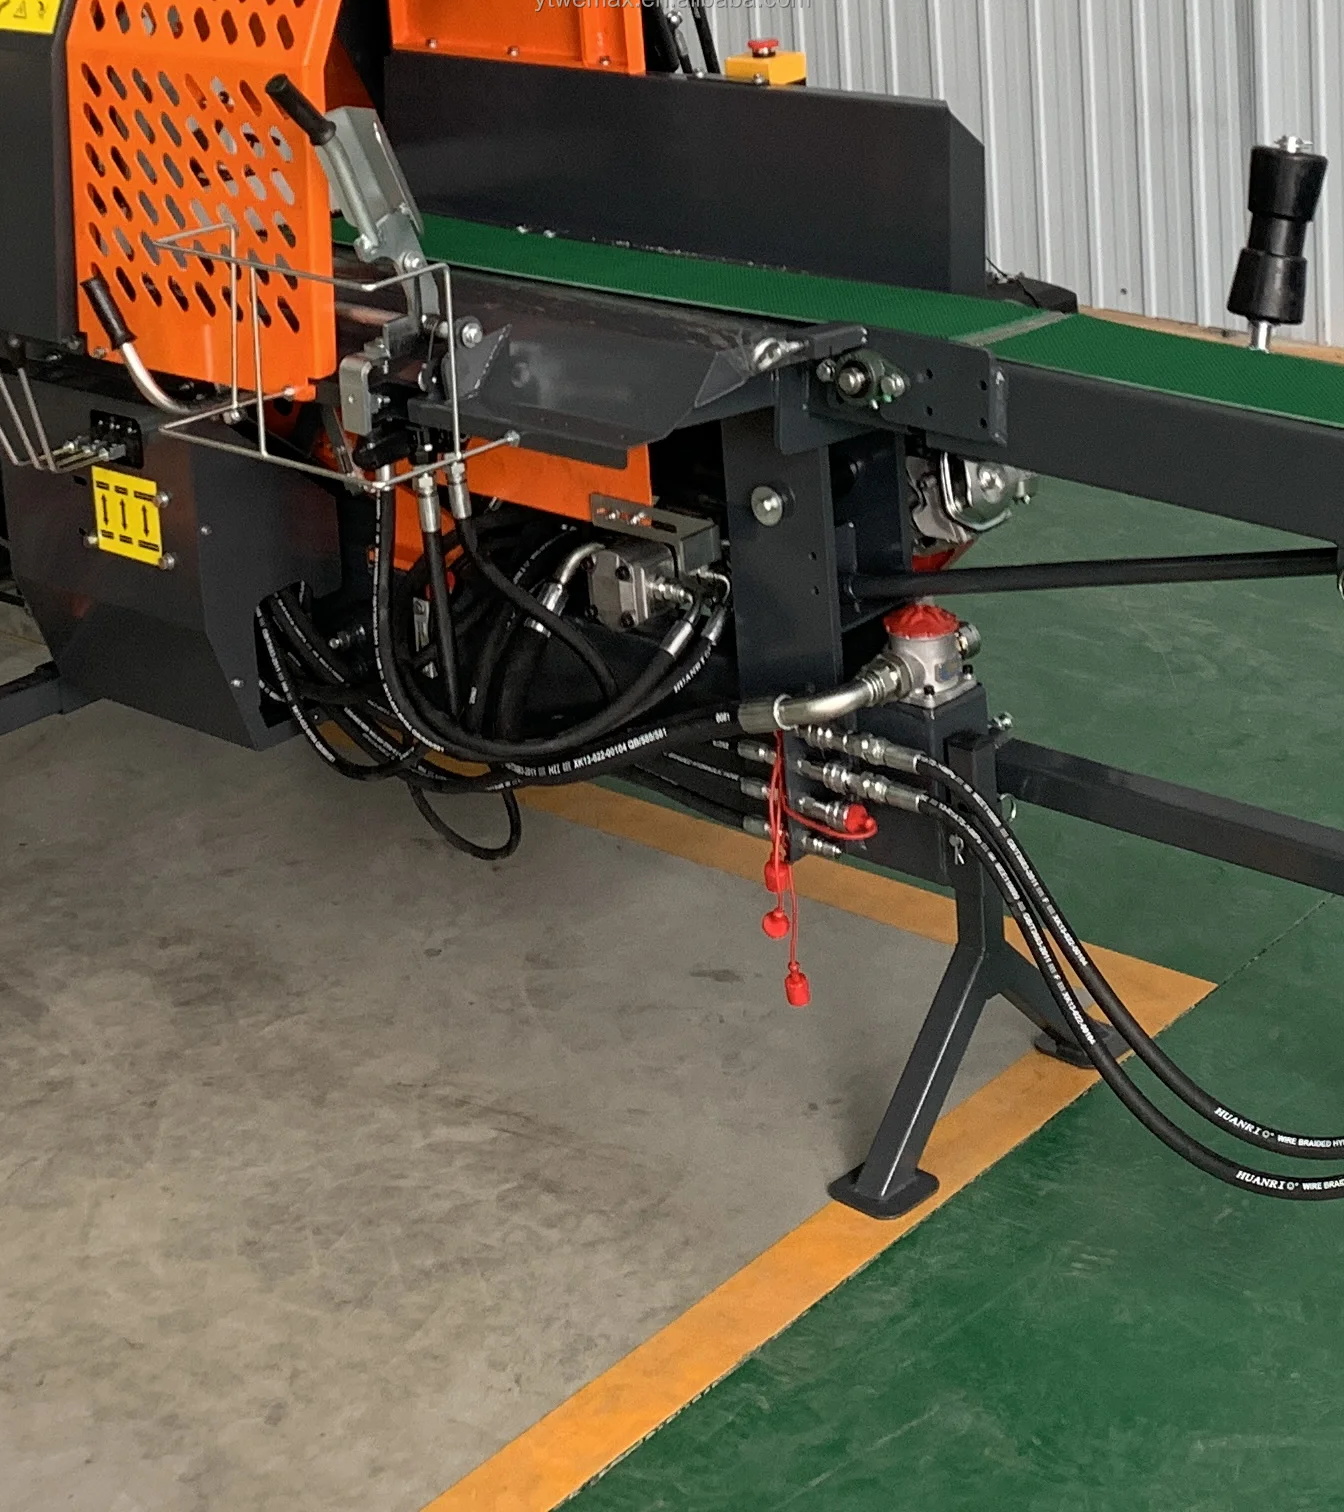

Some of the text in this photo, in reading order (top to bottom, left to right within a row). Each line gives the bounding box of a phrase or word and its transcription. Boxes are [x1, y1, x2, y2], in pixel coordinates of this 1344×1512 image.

[1214, 1106, 1262, 1136] HUANRI
[1277, 1134, 1297, 1146] WIRE
[1298, 1138, 1332, 1149] BRAIDED
[1235, 1170, 1287, 1190] HUANRI
[1302, 1182, 1323, 1191] WIRE
